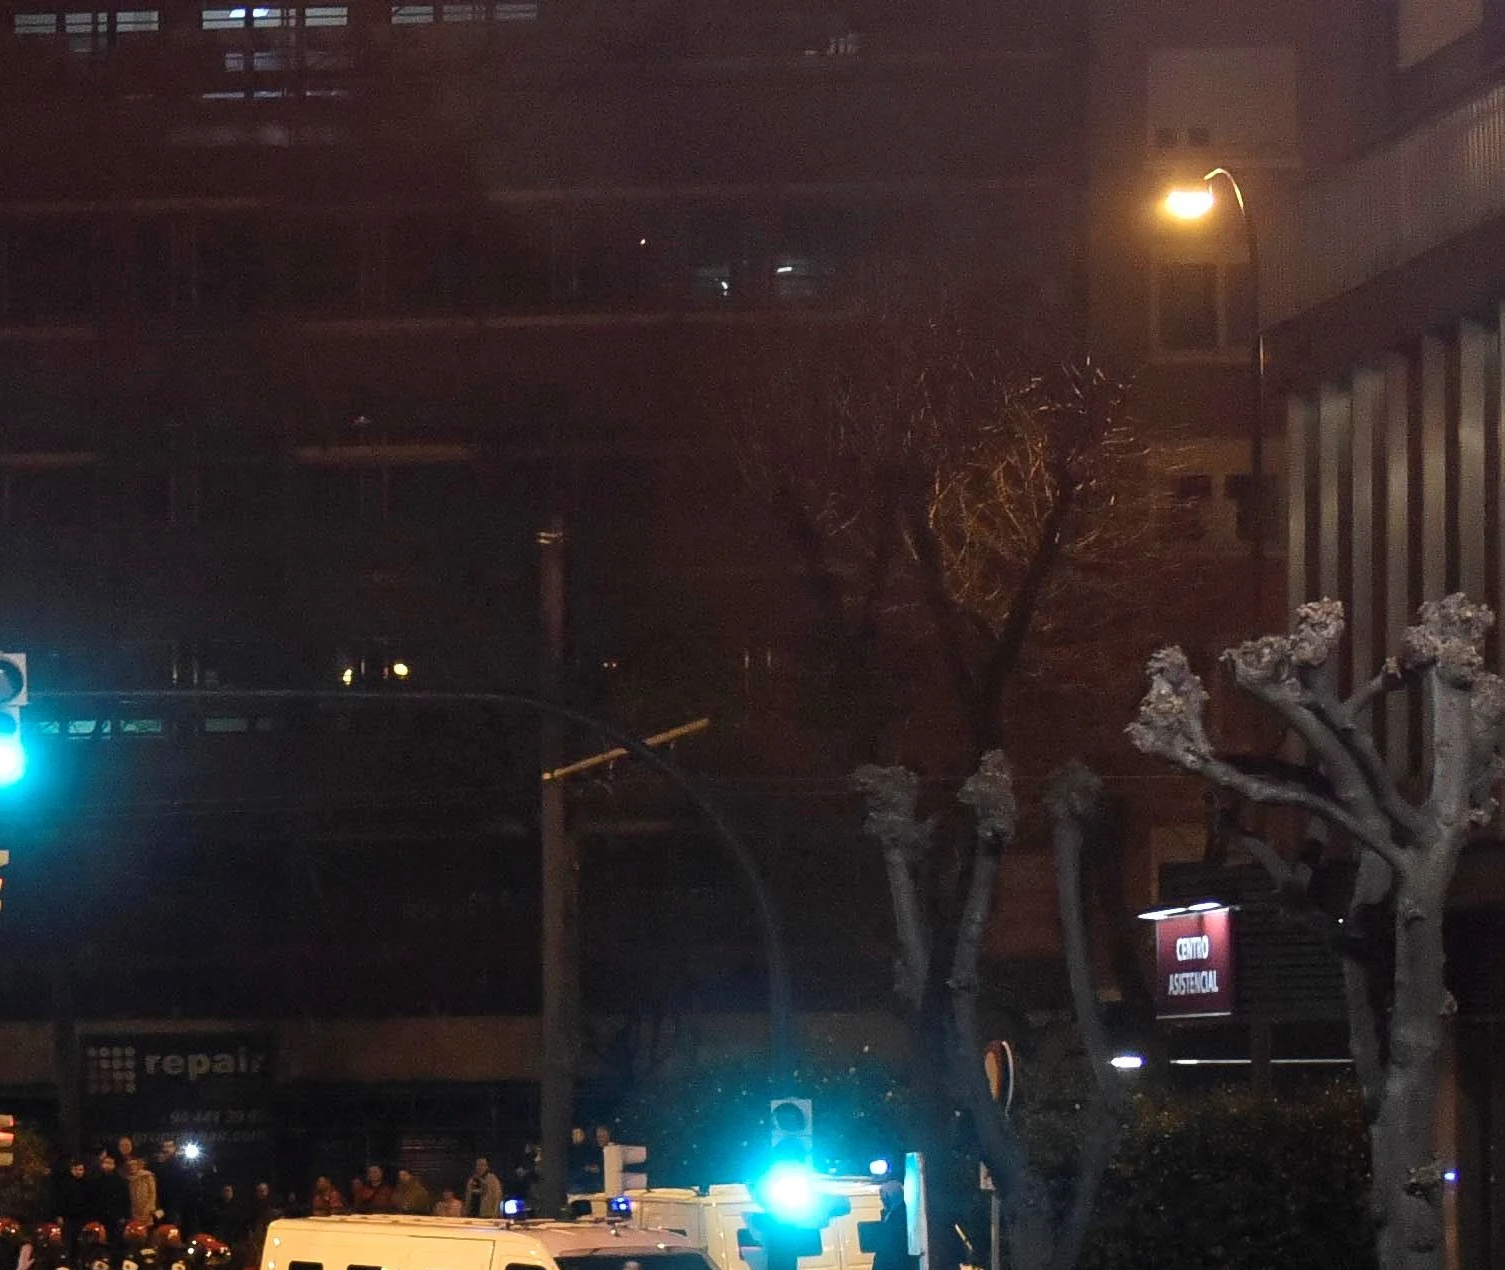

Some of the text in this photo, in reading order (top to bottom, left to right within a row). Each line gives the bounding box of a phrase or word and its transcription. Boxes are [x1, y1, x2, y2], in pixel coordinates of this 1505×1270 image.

[1176, 934, 1209, 962] CENTRO
[1168, 970, 1219, 996] ASISTENCIAL
[144, 1044, 265, 1081] repair
